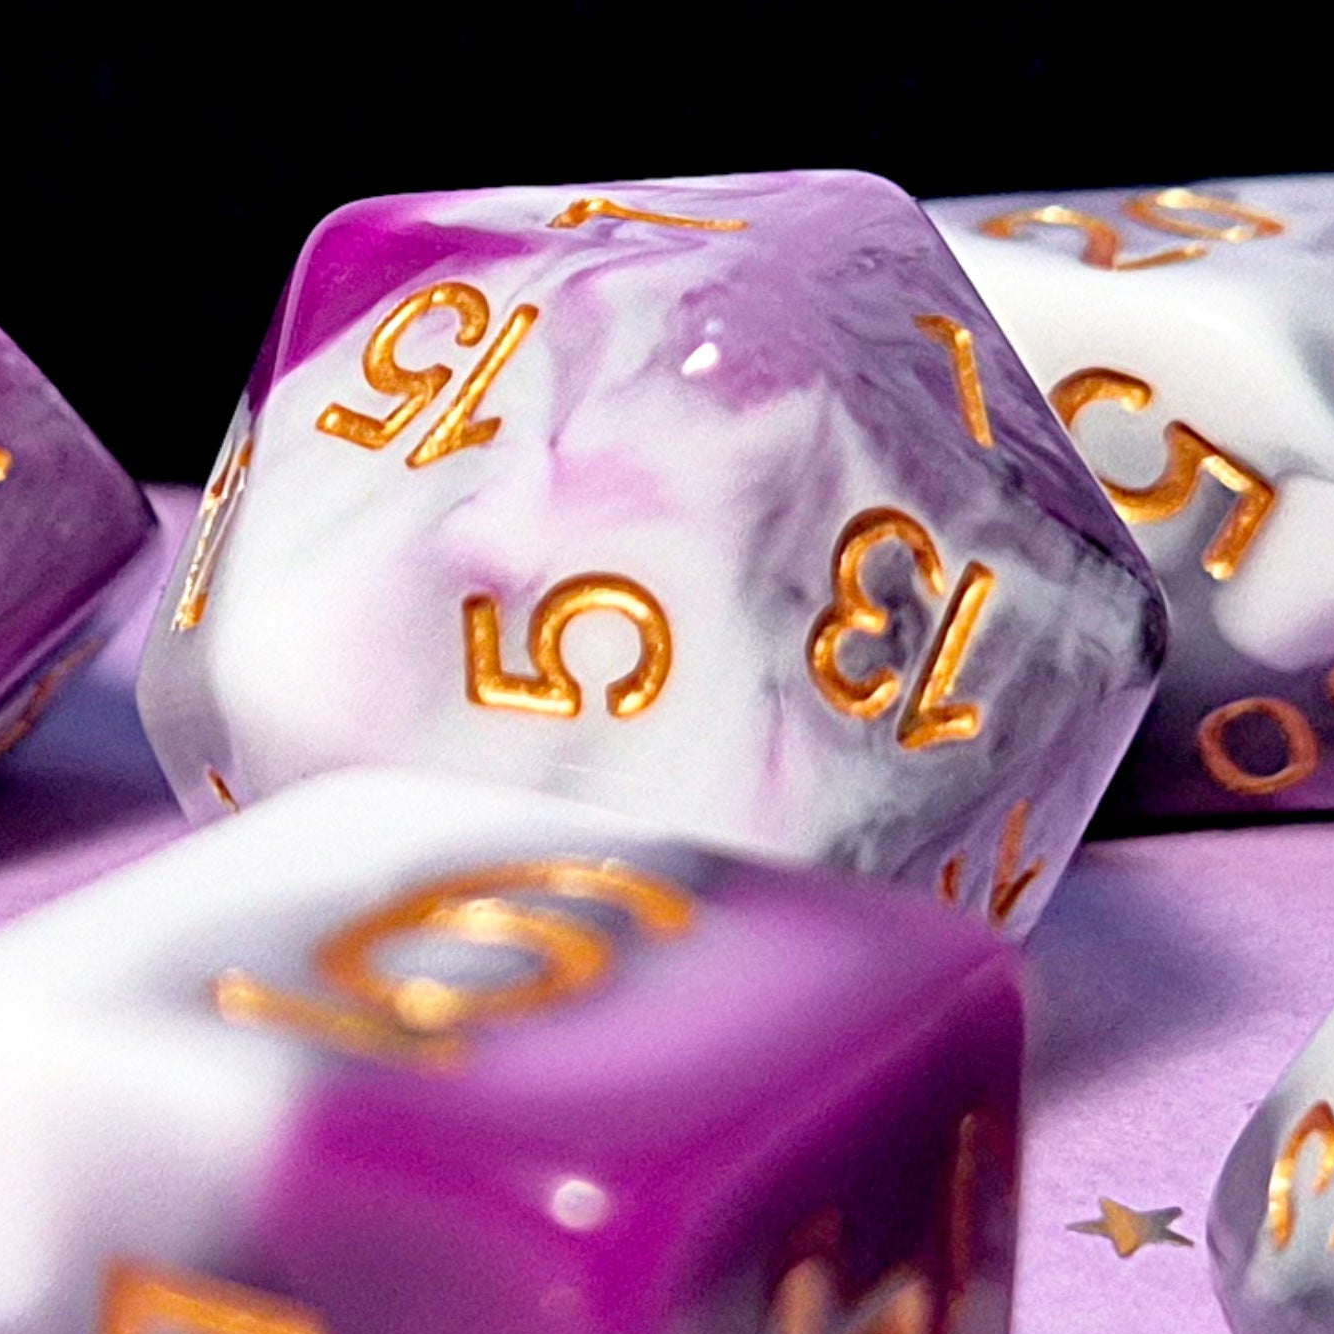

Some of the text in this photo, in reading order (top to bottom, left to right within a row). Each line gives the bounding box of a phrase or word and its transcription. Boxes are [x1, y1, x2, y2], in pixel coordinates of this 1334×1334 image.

[977, 187, 1285, 271] 20
[315, 280, 540, 468] 15
[1049, 365, 1278, 580] 5
[461, 570, 672, 720] 5
[805, 504, 995, 751] 13
